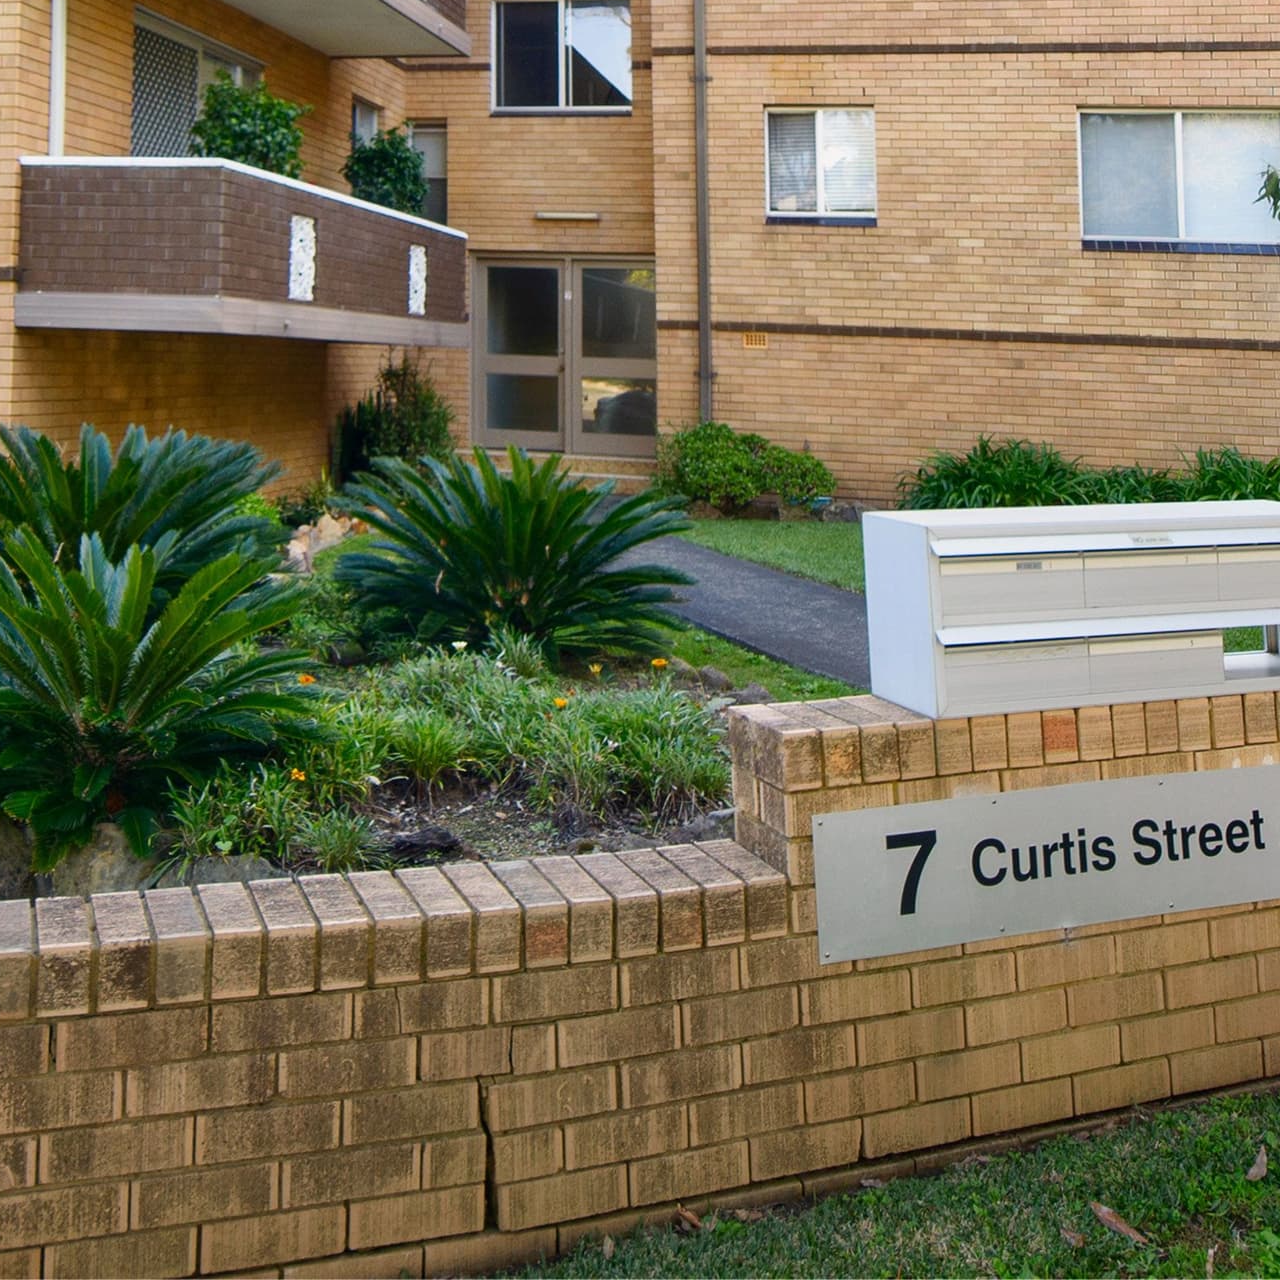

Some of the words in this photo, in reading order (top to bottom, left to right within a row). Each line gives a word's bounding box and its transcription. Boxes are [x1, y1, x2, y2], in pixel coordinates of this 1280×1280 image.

[885, 829, 937, 916] 7
[971, 827, 1117, 887] Curtis
[1132, 809, 1266, 866] Street
